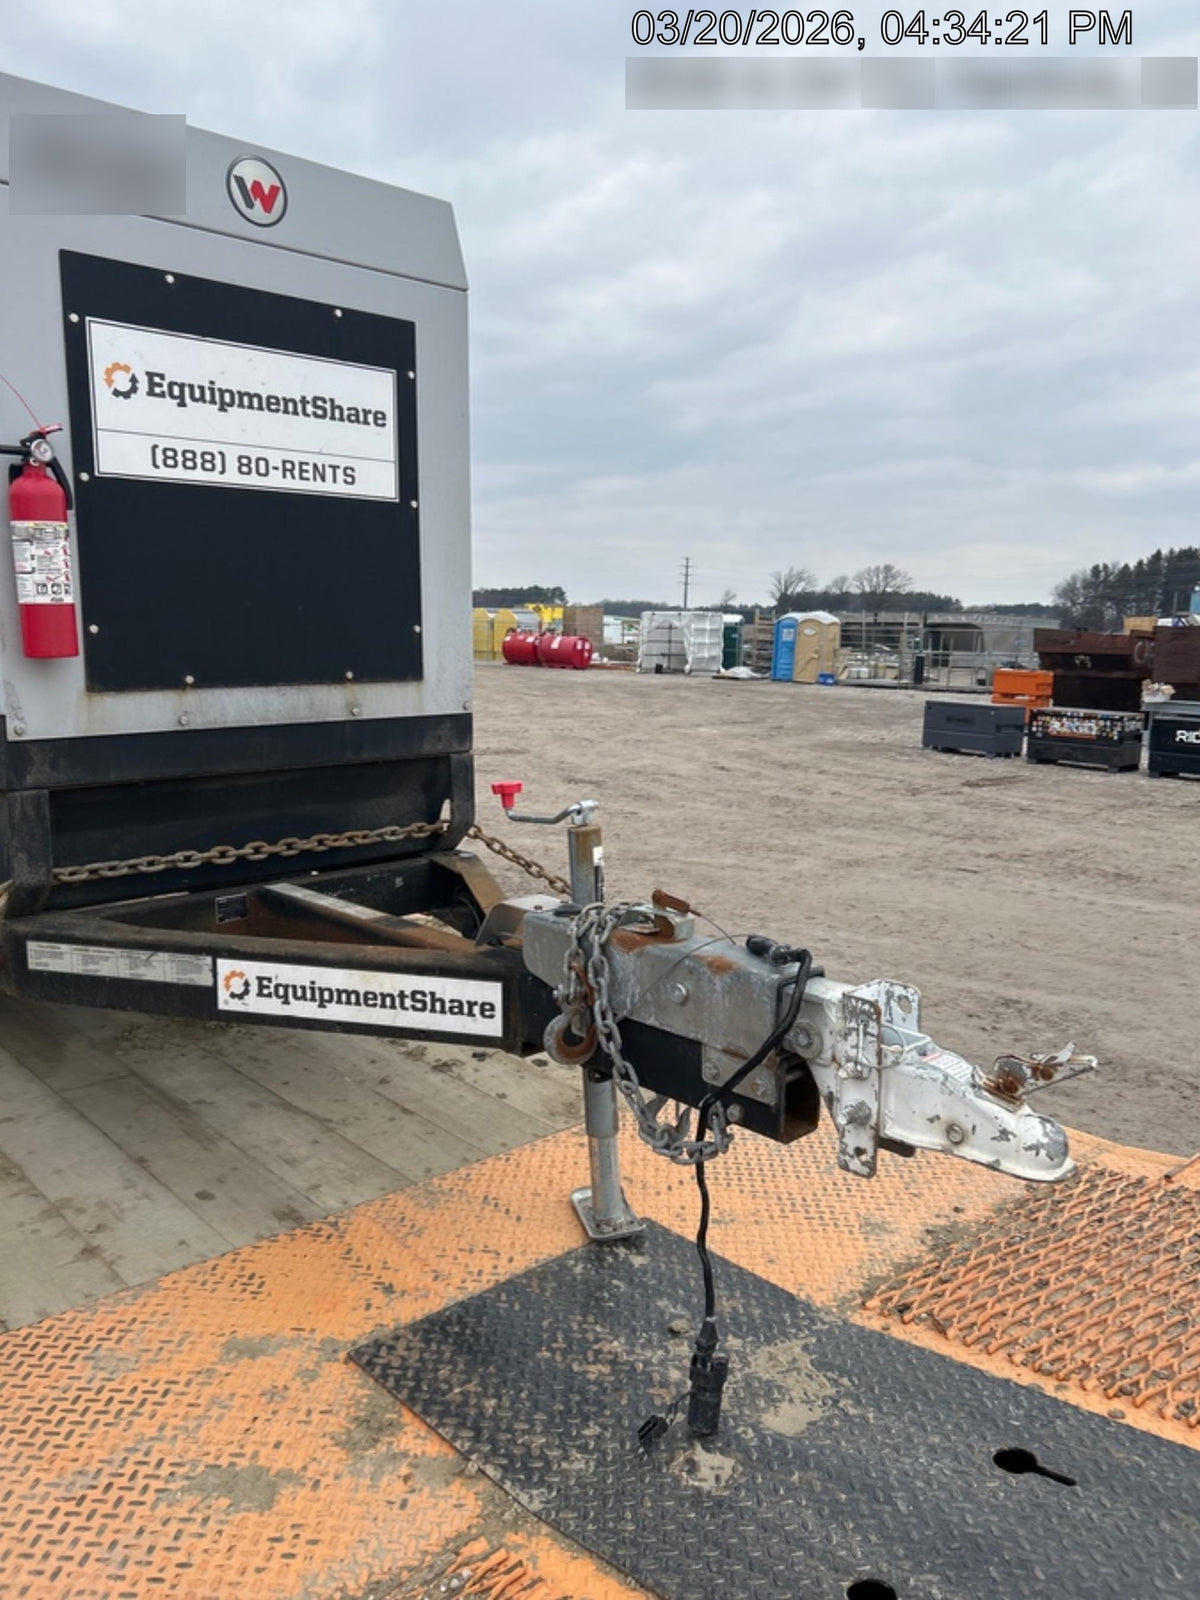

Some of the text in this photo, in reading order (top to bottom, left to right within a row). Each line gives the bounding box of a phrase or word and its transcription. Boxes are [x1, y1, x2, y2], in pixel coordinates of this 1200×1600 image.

[145, 371, 387, 428] EquipmentShare
[151, 444, 356, 486] (888) 80-RENTS
[255, 976, 497, 1019] EquipmentShare
